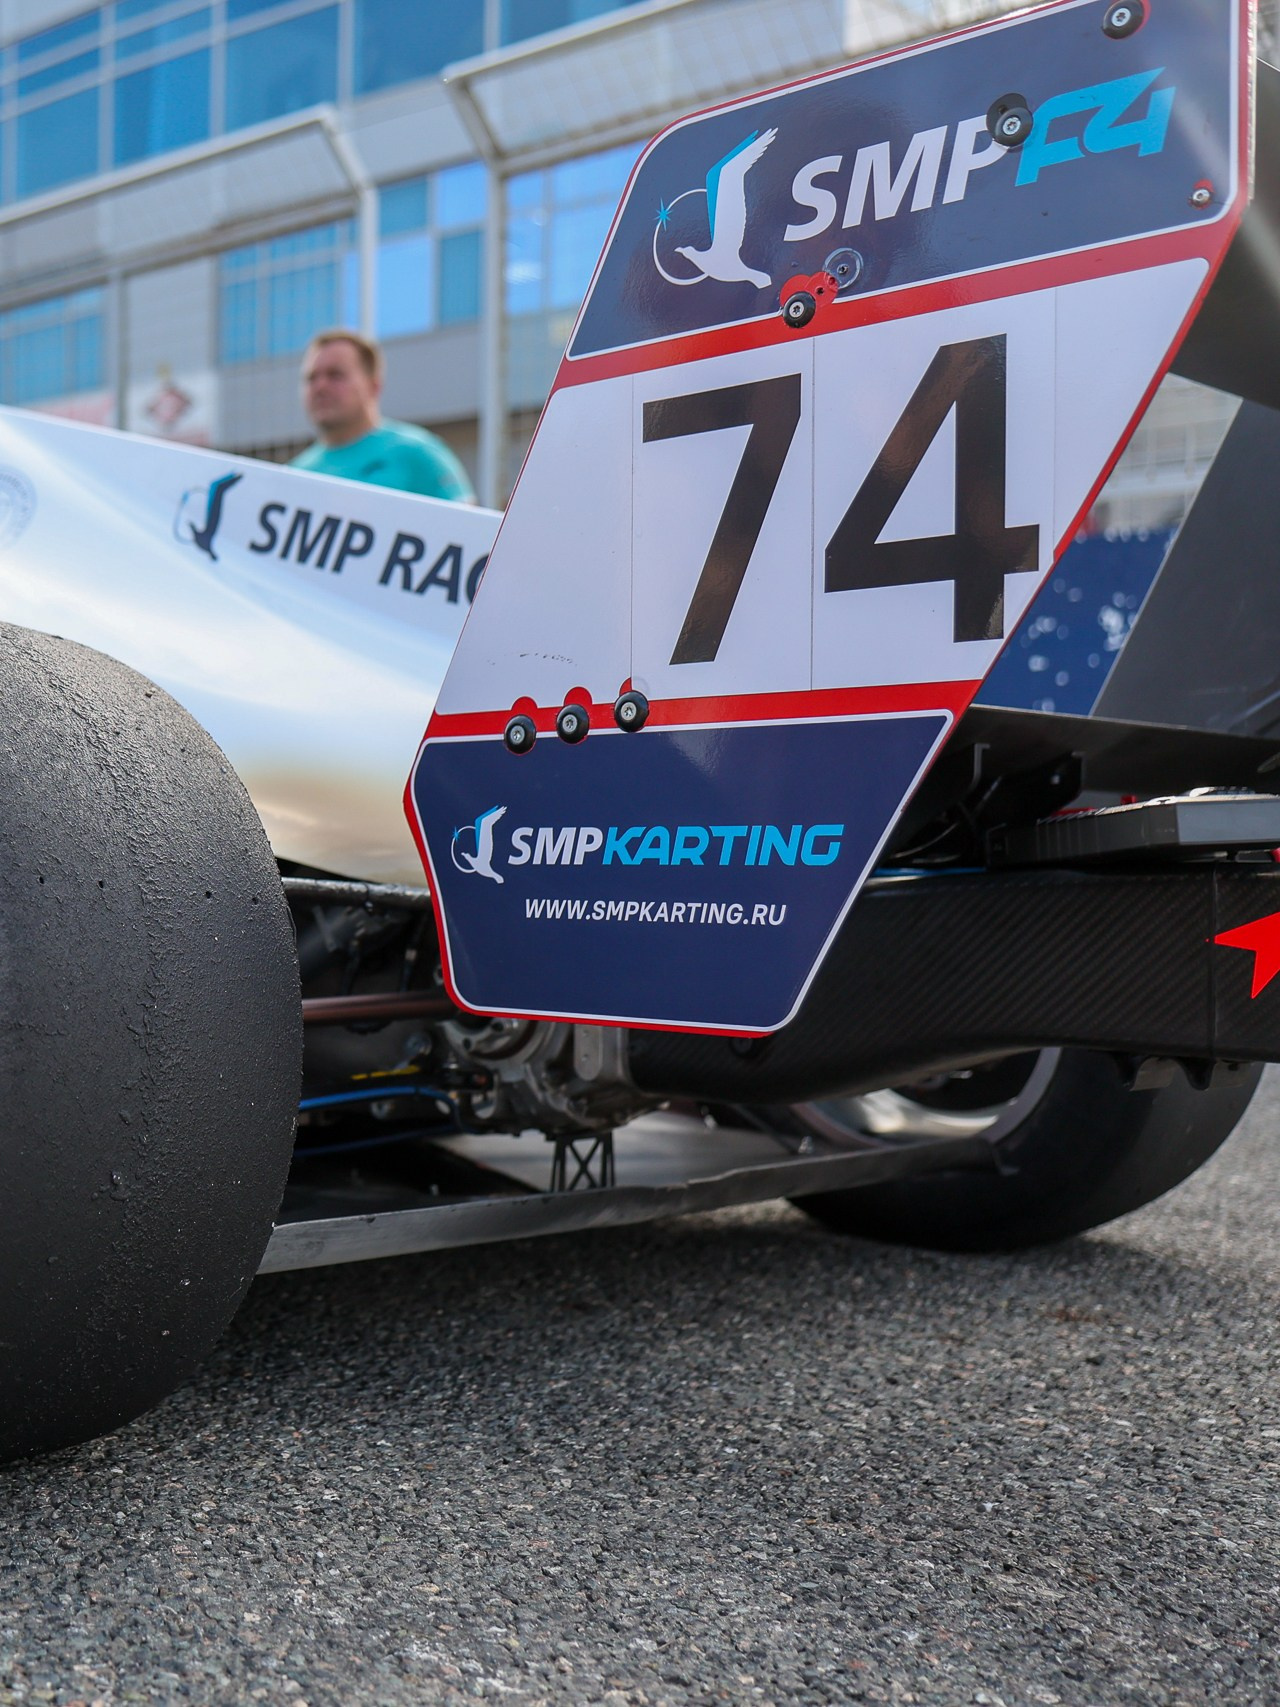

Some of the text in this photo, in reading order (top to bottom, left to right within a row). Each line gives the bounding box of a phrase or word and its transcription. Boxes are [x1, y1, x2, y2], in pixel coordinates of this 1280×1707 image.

[643, 333, 1040, 665] 74
[249, 503, 375, 575] SMP
[525, 898, 787, 926] WWW.SMPKARTING.RU
